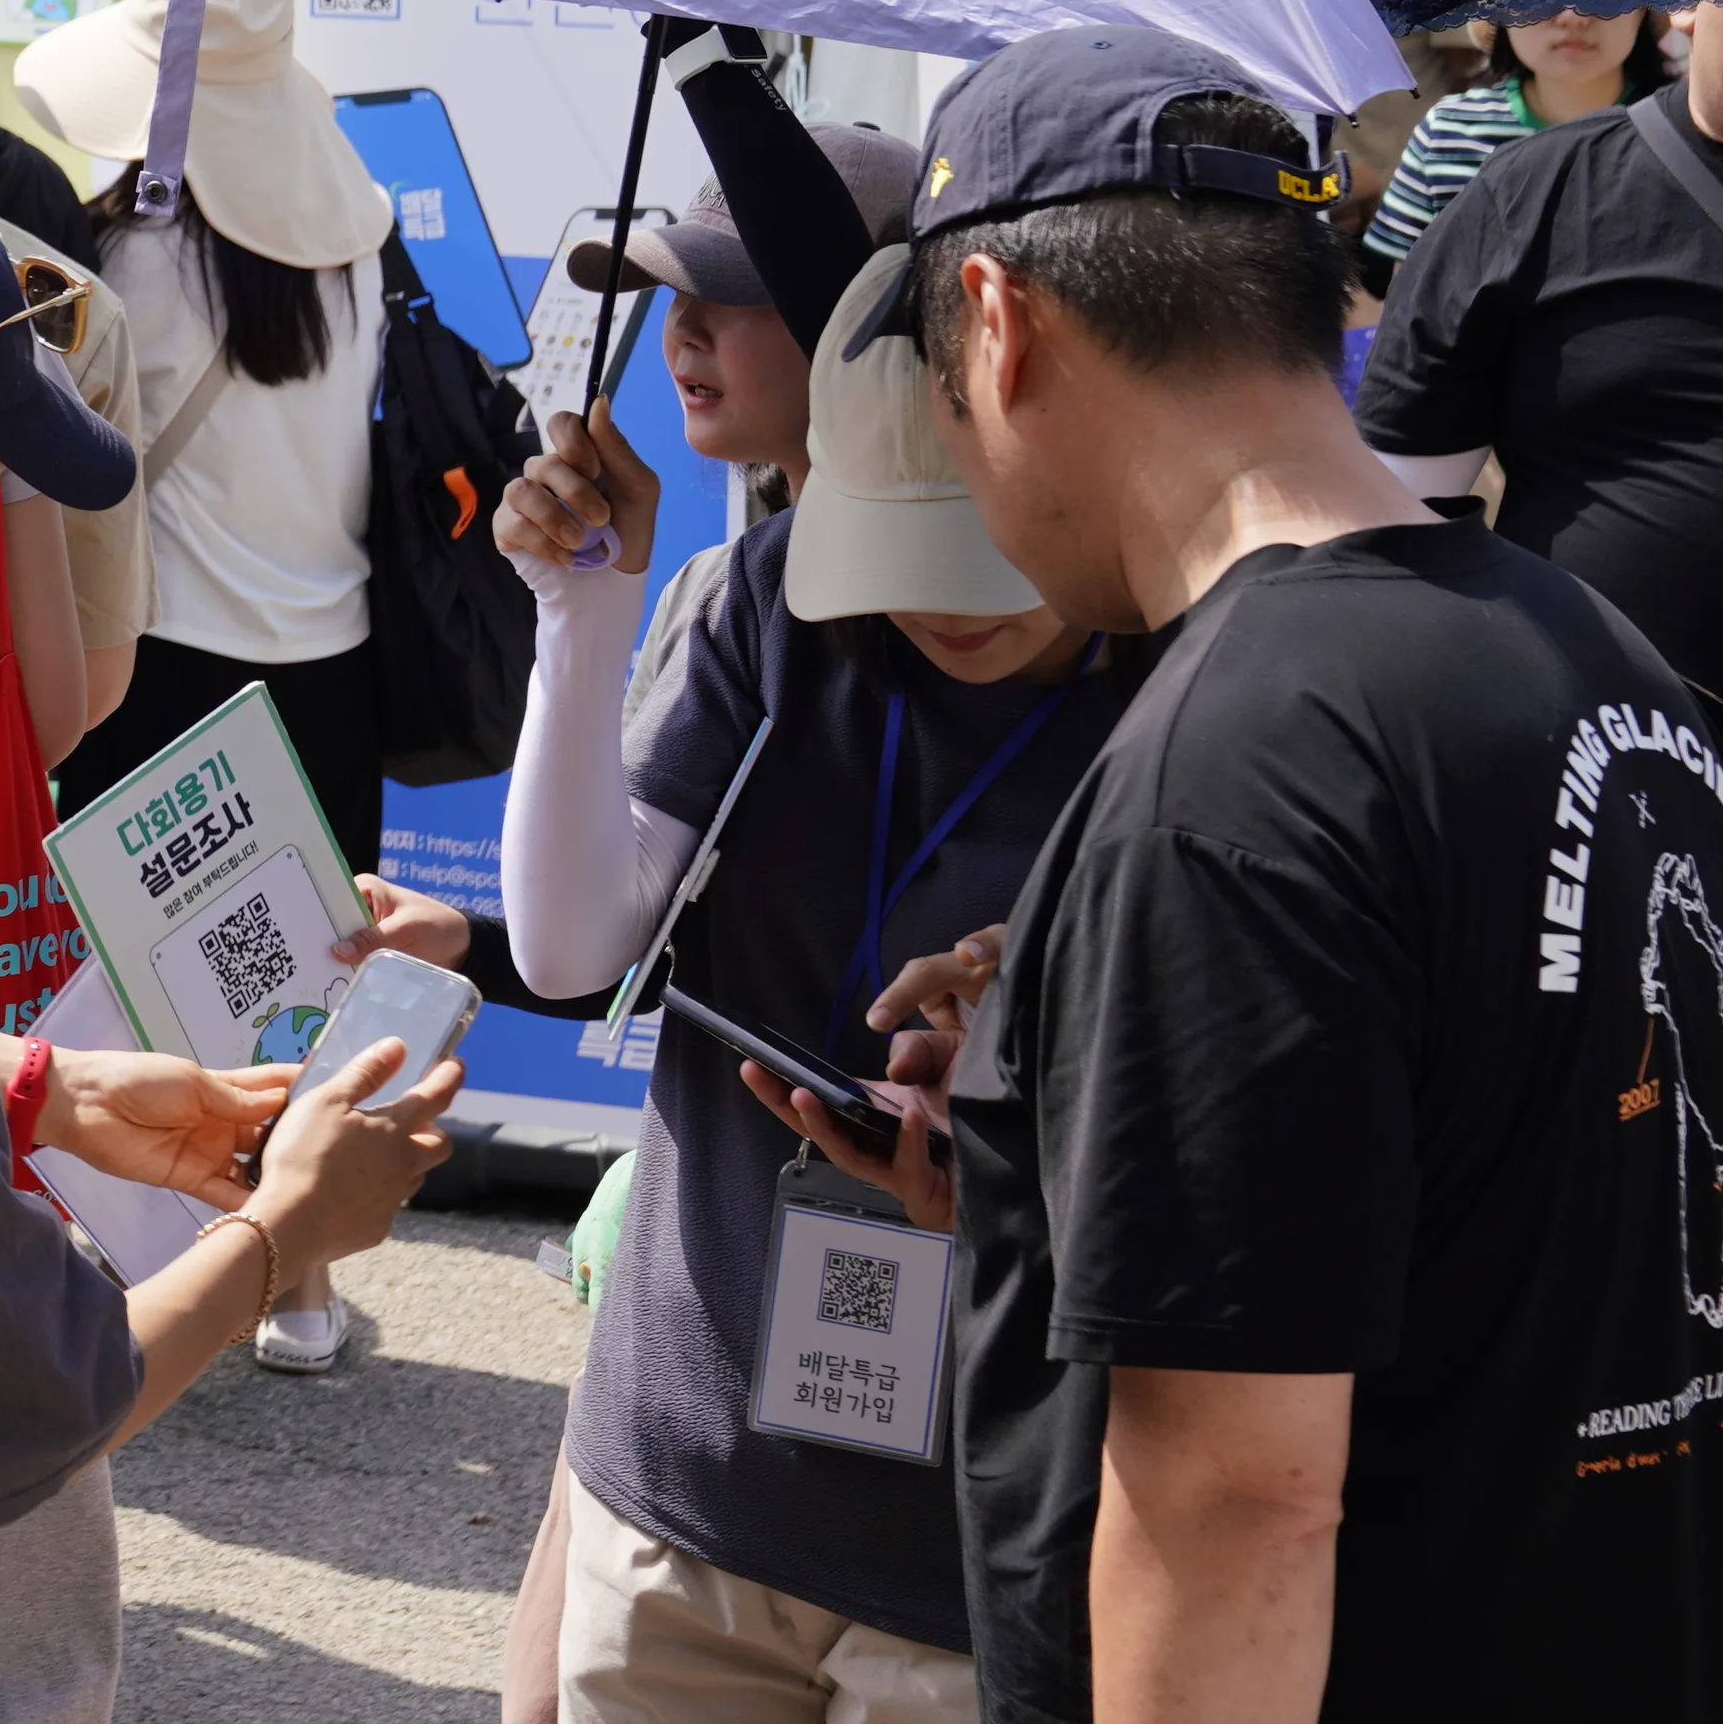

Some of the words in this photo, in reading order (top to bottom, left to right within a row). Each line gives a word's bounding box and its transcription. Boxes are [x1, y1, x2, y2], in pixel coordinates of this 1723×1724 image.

[1278, 170, 1340, 203] UCLA
[116, 749, 237, 857] 다회용기
[140, 792, 254, 899] 설문조사
[427, 834, 503, 861] https://s
[1538, 718, 1611, 994] MELTING
[163, 897, 185, 919] 많은
[184, 883, 204, 905] 참여
[204, 840, 260, 889] 부탁드립니다!
[410, 860, 503, 889] help@spc
[798, 1350, 901, 1393] 배달특급
[793, 1381, 895, 1425] 회원가입
[1587, 1398, 1672, 1439] READING
